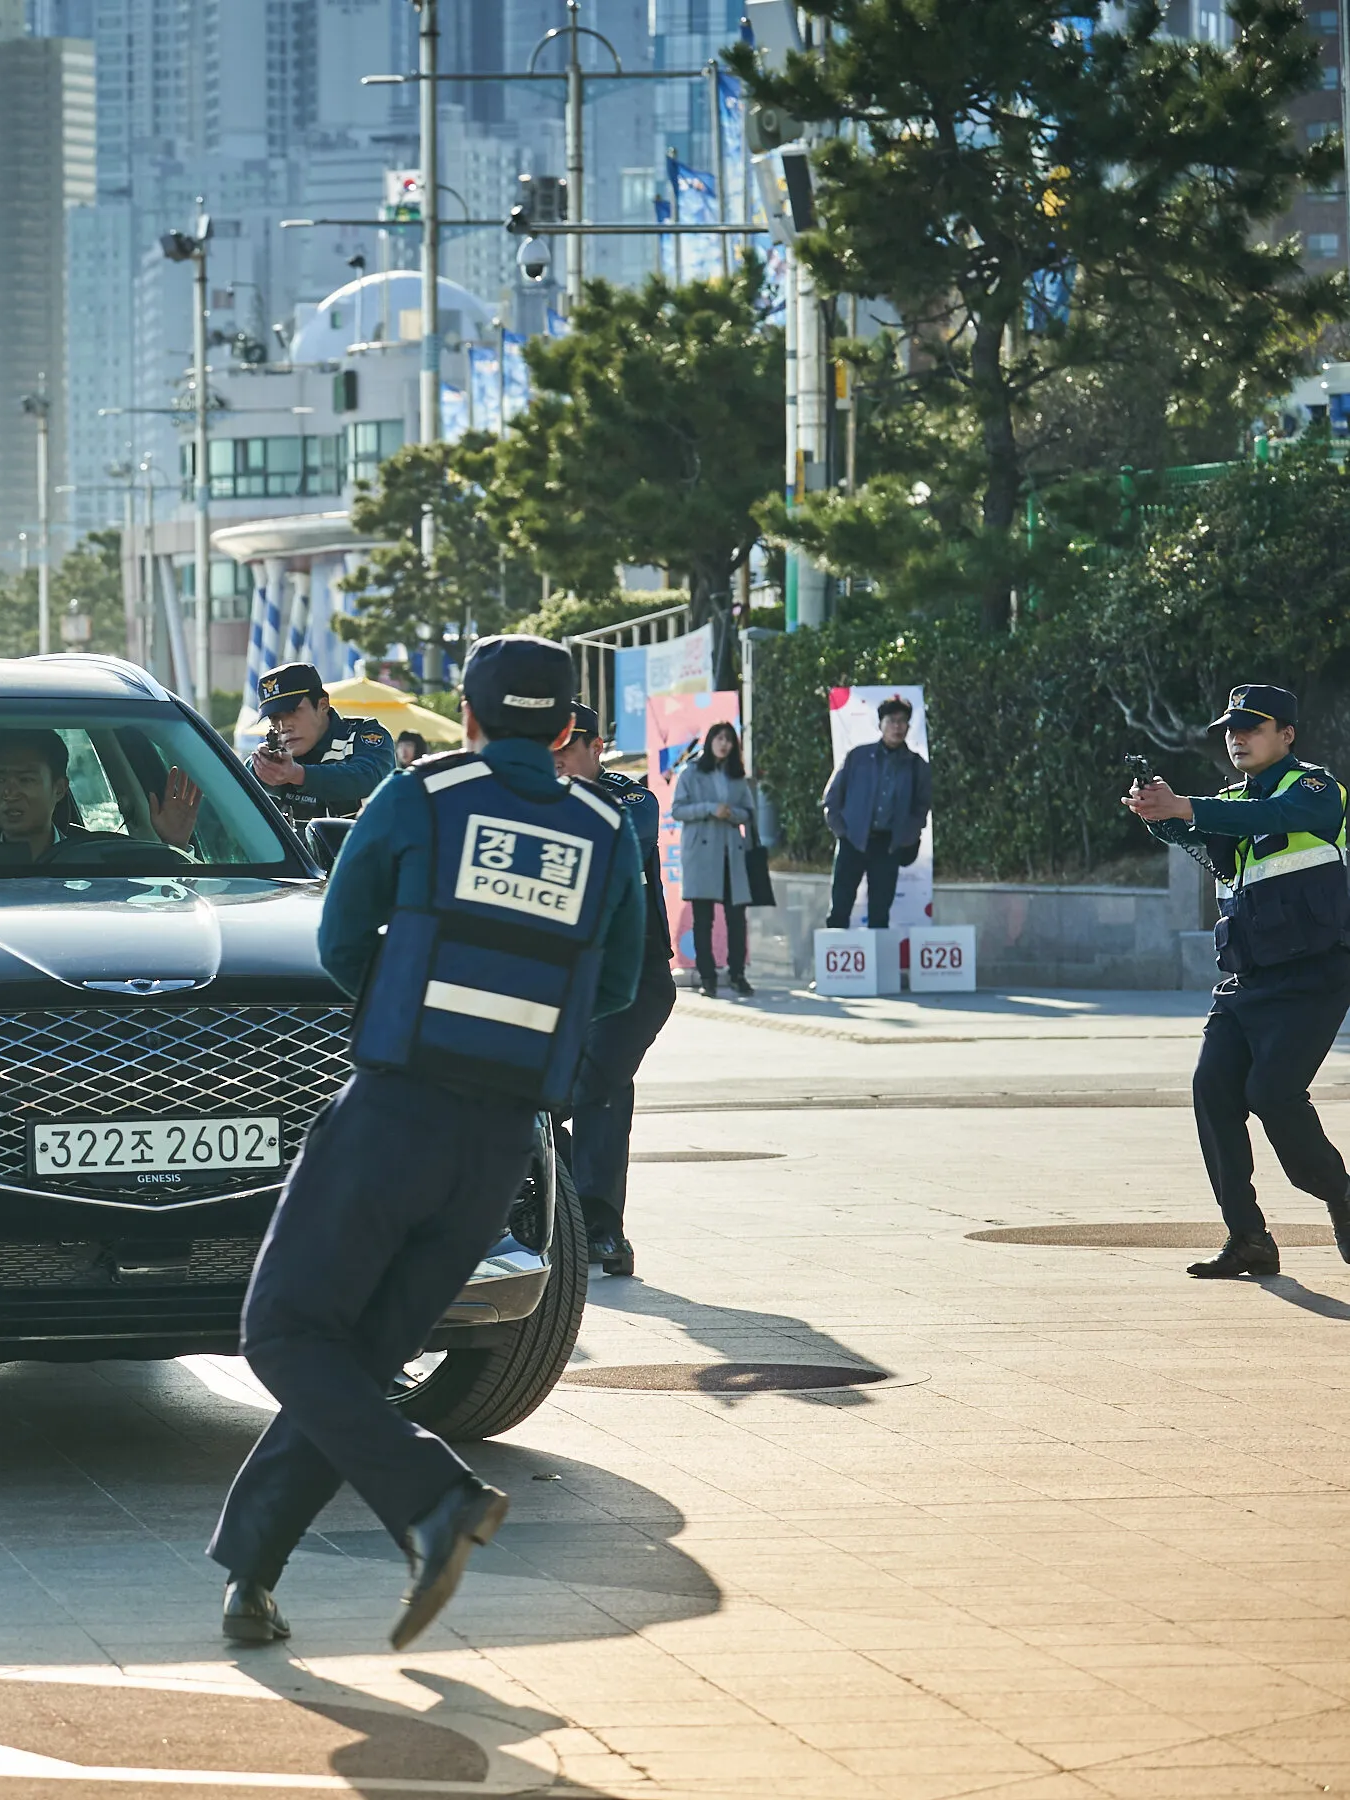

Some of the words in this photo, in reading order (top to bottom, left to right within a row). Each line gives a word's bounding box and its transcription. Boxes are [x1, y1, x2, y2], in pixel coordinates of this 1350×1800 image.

[473, 875, 570, 911] POLICE
[826, 950, 865, 973] G20
[920, 947, 962, 969] G20
[166, 1123, 265, 1165] 2602
[137, 1173, 181, 1183] GENESIS
